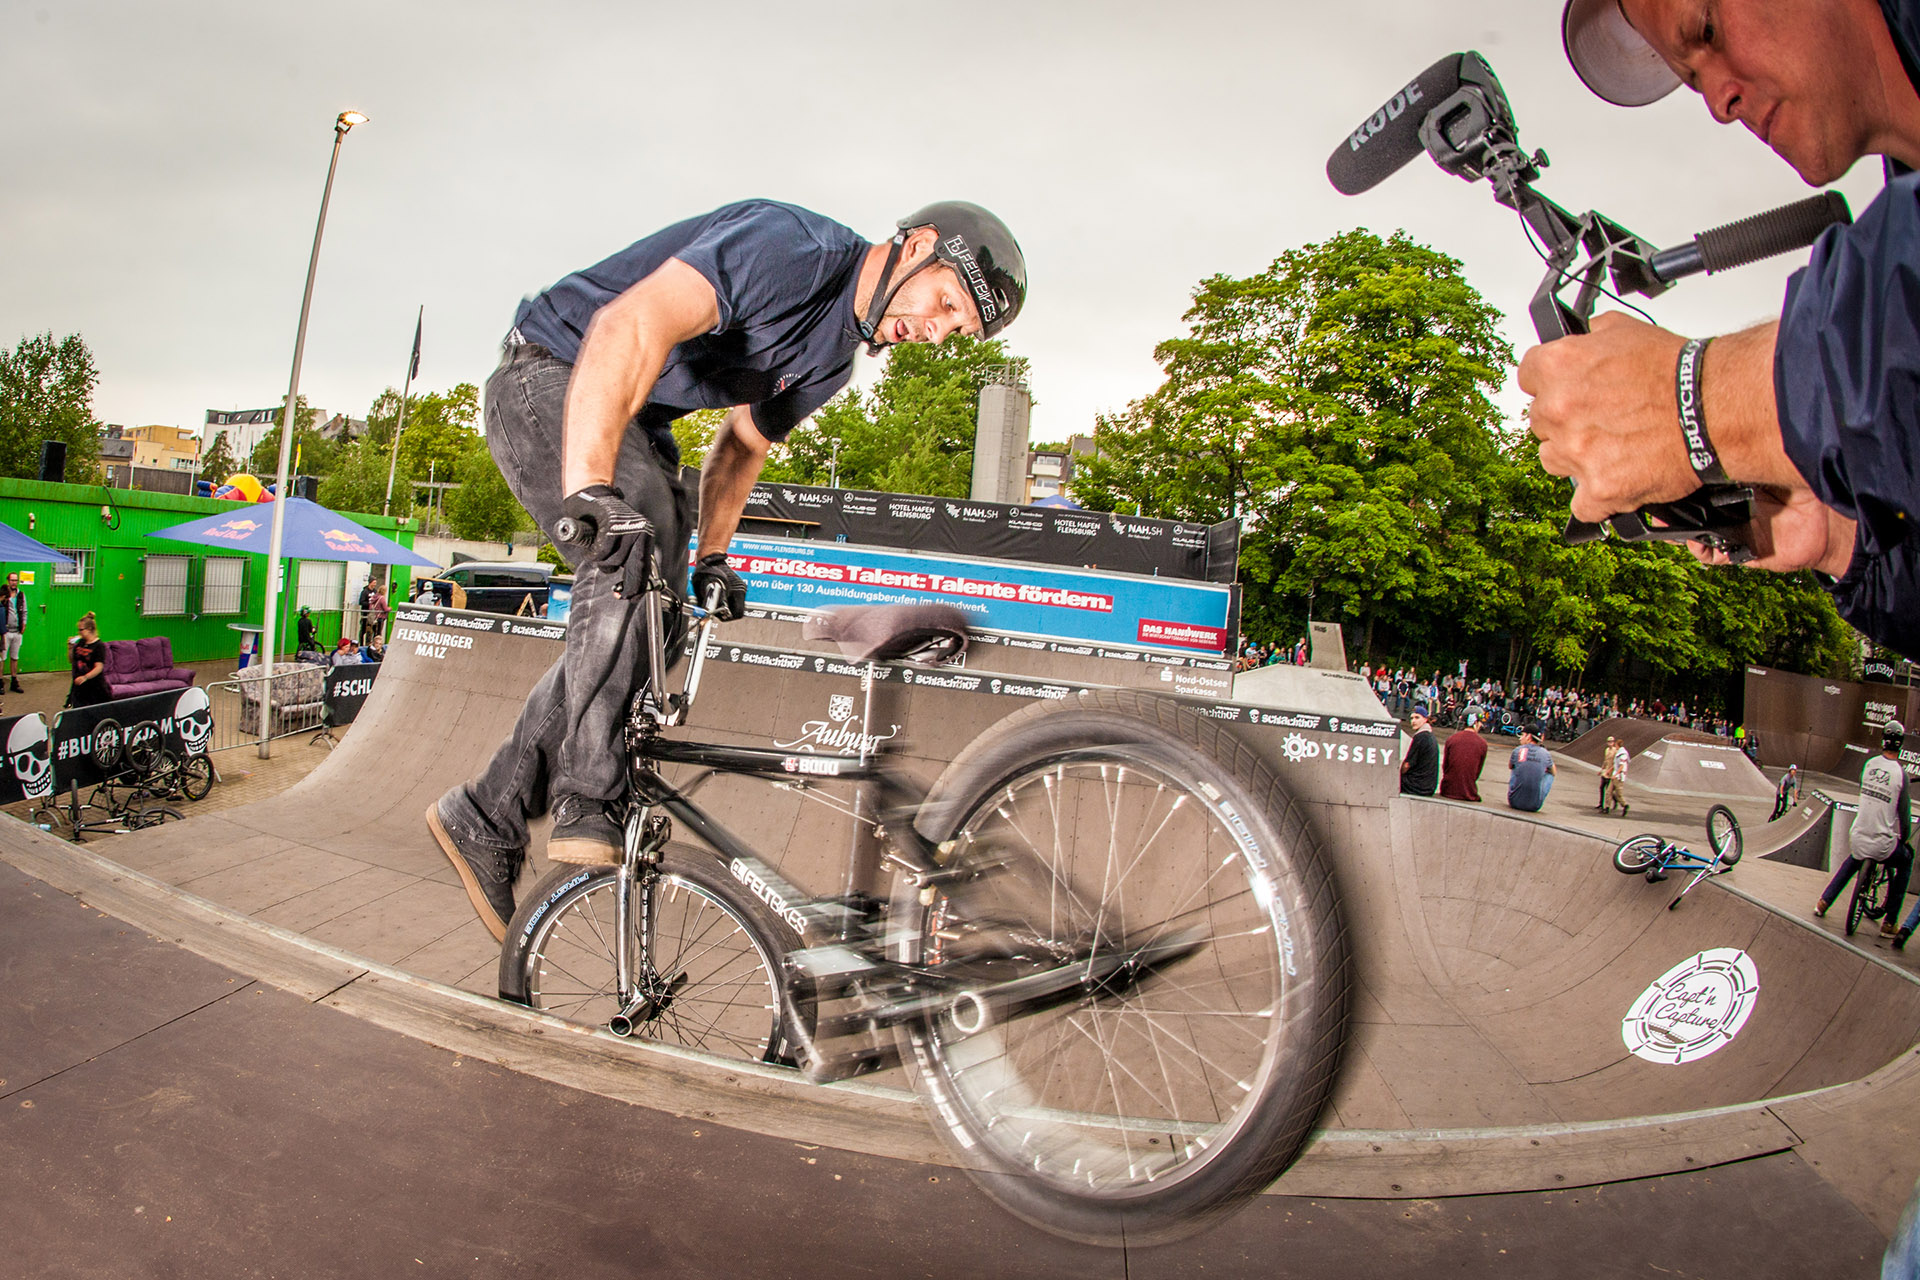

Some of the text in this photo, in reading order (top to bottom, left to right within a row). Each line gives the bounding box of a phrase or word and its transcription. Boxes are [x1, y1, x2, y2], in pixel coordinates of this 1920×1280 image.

[1680, 349, 1704, 449] BUTCHER
[747, 498, 769, 506] SBURG
[799, 493, 834, 504] NAH.SH
[889, 503, 936, 514] HOTEL HAFEN
[891, 511, 932, 520] FLENSBURG
[963, 508, 998, 519] NAH.SH
[1054, 519, 1100, 530] HOTEL HAFEN
[1057, 527, 1097, 536] FLENSBURG
[1128, 524, 1163, 536] NAH.SH
[750, 558, 844, 581] größtes
[846, 565, 926, 588] Talent:
[928, 575, 1015, 600] Talente
[1018, 586, 1114, 611] fördern.
[751, 579, 769, 588] von
[771, 579, 794, 591] über
[797, 584, 814, 594] 130
[816, 585, 917, 605] Ausbildungsberufen
[397, 629, 474, 649] FLENSBURGER
[1142, 625, 1218, 640] DAS HANDWERK
[415, 644, 447, 659] MALZ
[1175, 674, 1228, 688] Nord-Ostsee
[1175, 685, 1217, 697] Sparkasse
[743, 870, 808, 936] FELTBIKES
[1665, 982, 1716, 1008] Capt'n
[1655, 1002, 1718, 1029] Capture
